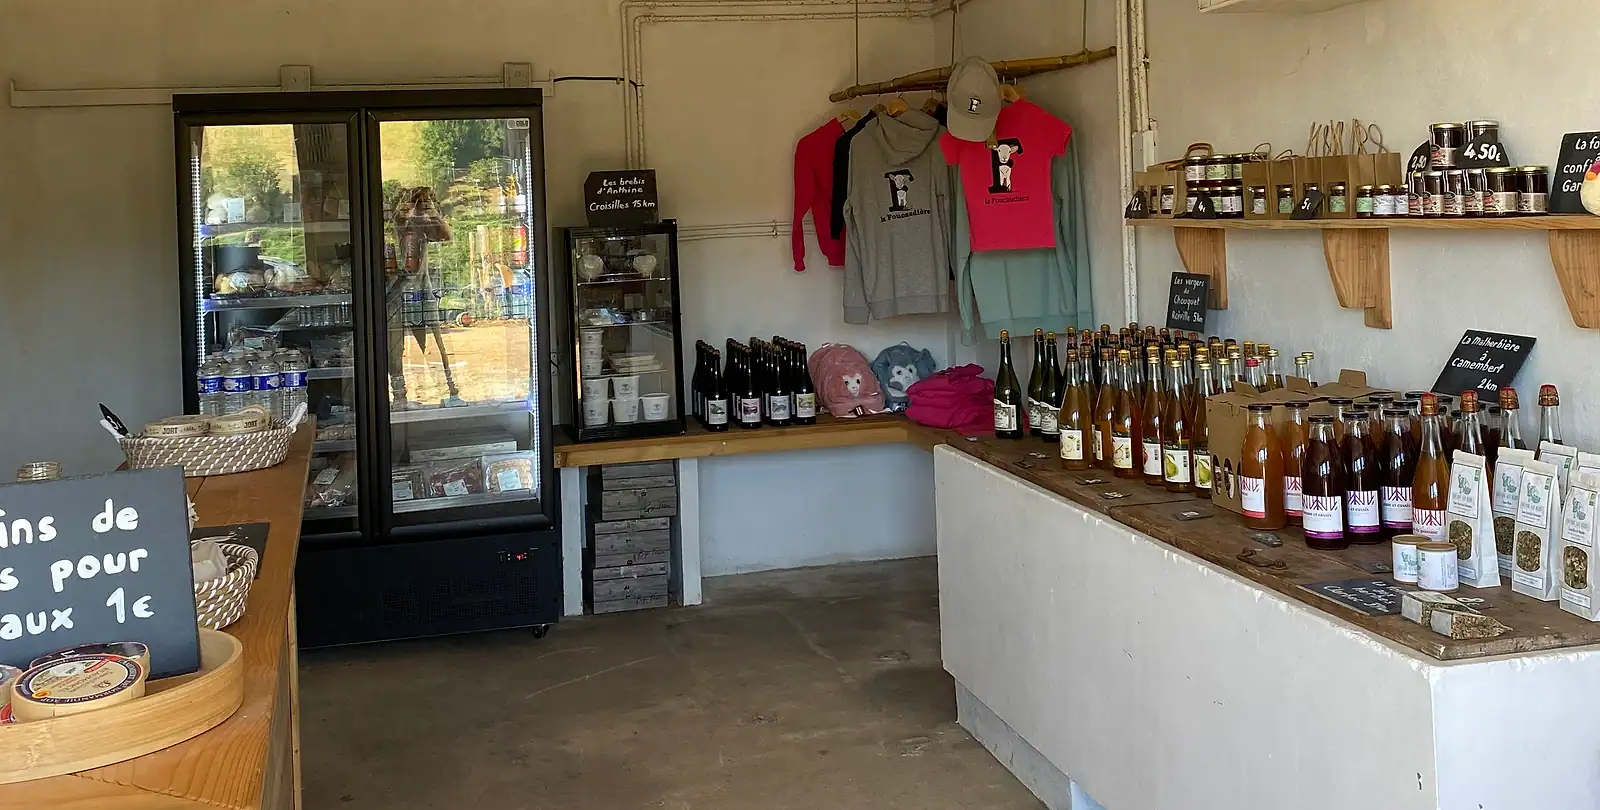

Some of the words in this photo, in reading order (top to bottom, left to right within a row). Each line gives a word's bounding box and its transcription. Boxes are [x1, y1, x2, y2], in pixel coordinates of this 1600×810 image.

[1575, 138, 1587, 150] La
[603, 179, 616, 187] Les
[620, 176, 645, 186] brebis
[589, 199, 629, 212] Croisilles
[1174, 276, 1183, 285] Les
[1185, 279, 1205, 290] vergers
[1461, 335, 1472, 345] La
[1471, 336, 1521, 352] Malherbière
[244, 420, 258, 428] JORT
[162, 427, 178, 435] JORT
[92, 498, 139, 533] de
[50, 548, 148, 593] pour
